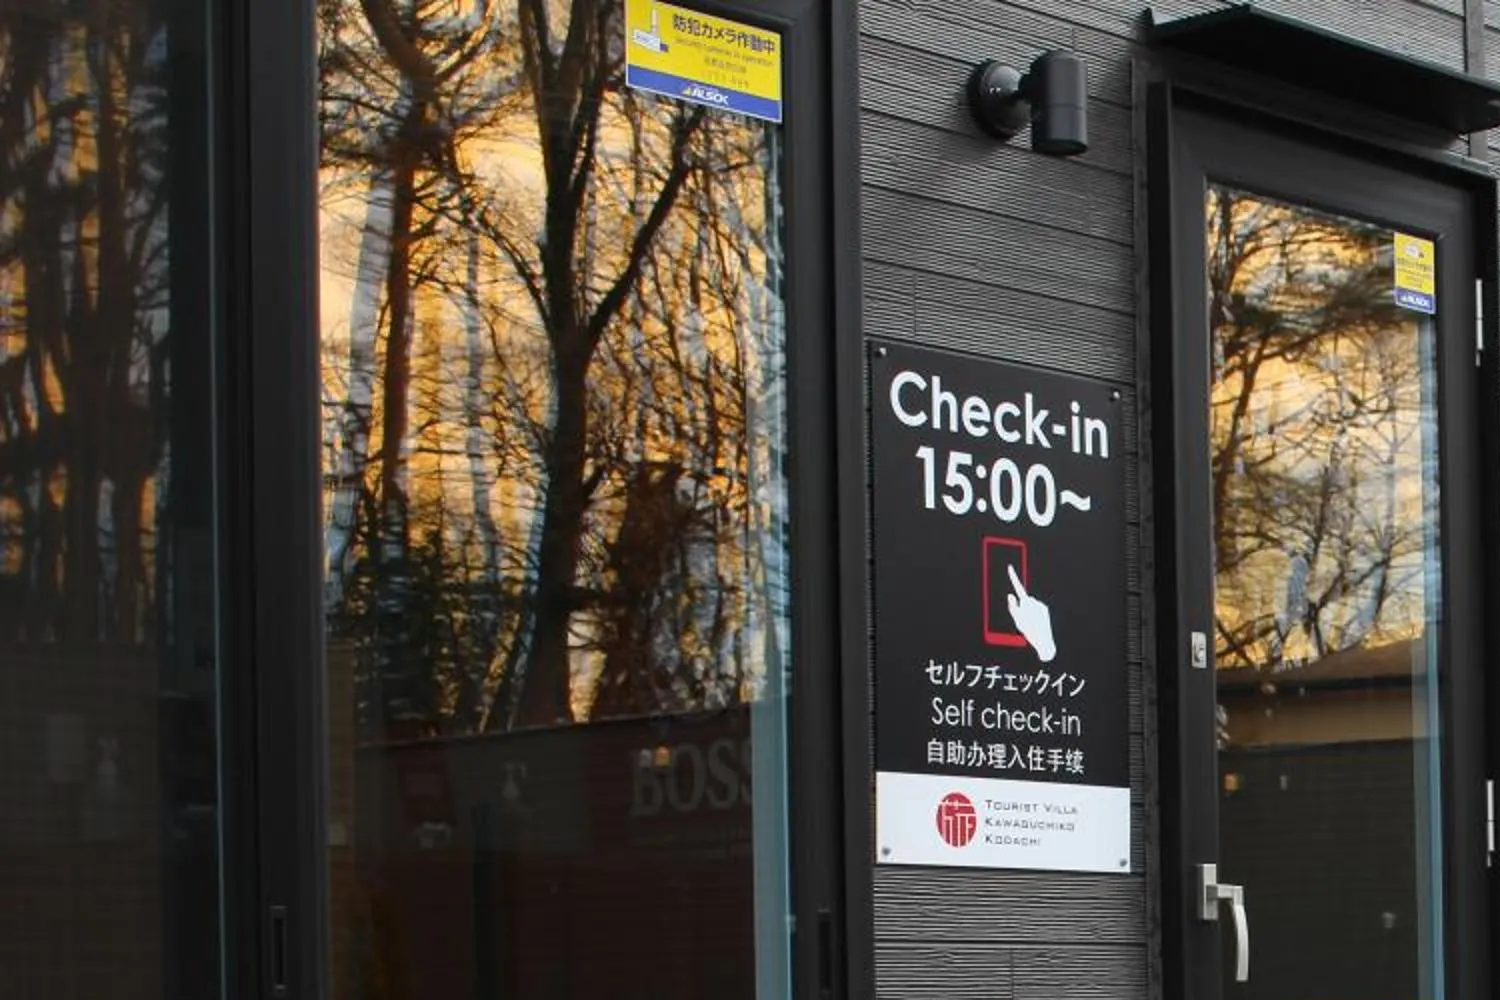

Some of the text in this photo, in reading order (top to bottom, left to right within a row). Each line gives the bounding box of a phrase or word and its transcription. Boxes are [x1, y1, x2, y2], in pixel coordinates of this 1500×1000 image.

[890, 371, 1109, 458] Check-in
[925, 659, 1085, 697] セルフチェックイン
[932, 697, 1081, 736] Self check-in
[927, 738, 1085, 774] 自助办理入住手续
[985, 800, 1078, 815] TOURIST VILLA
[985, 817, 1075, 832] KAWAGUCHIKO
[985, 834, 1041, 847] KODACHI
